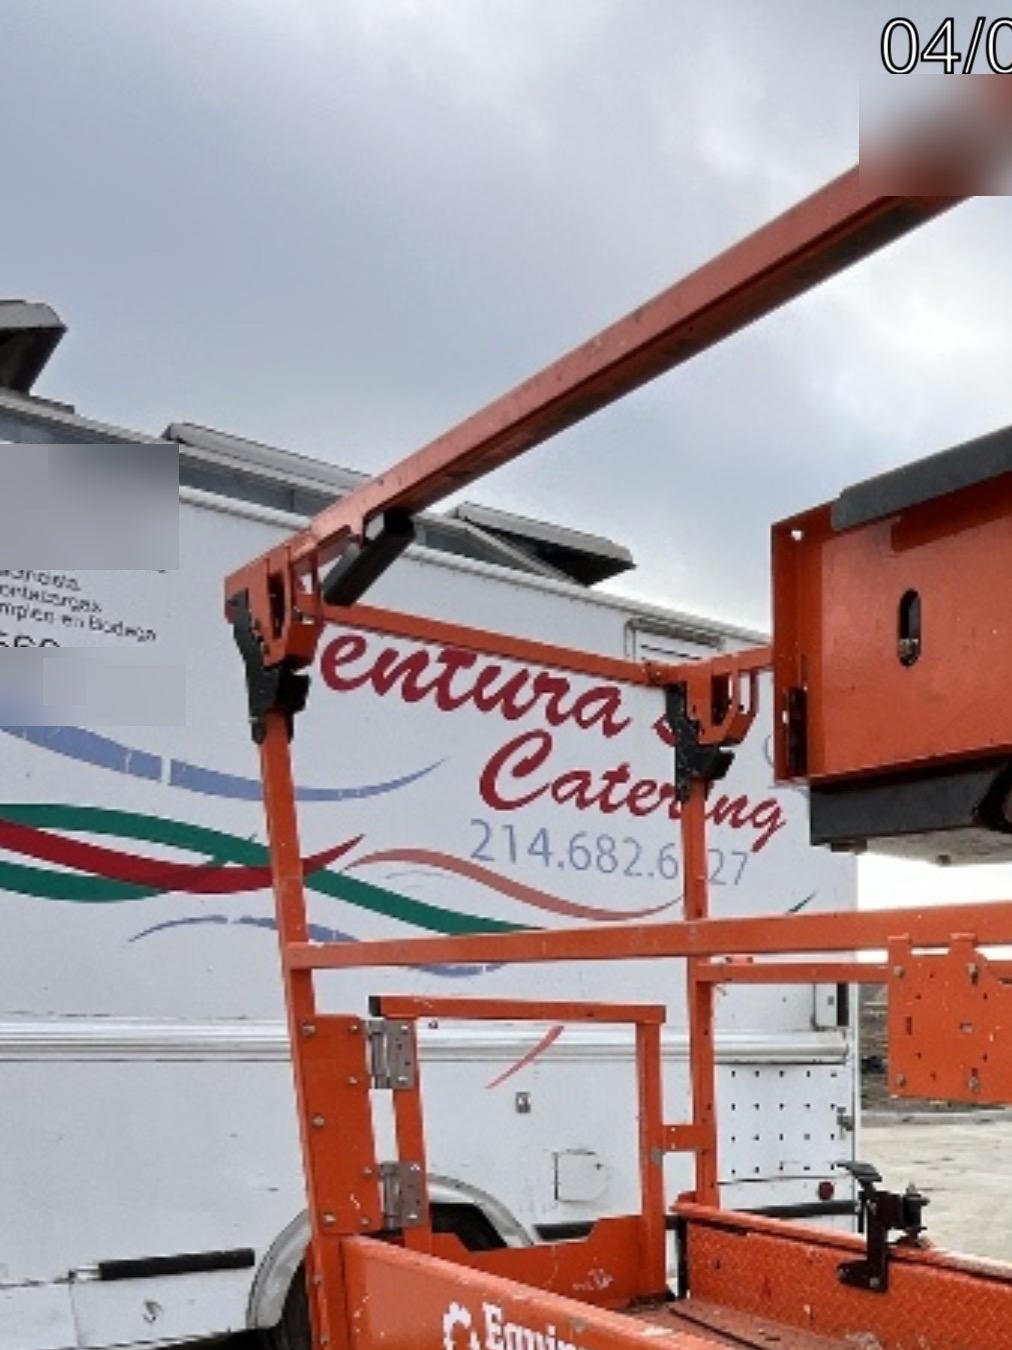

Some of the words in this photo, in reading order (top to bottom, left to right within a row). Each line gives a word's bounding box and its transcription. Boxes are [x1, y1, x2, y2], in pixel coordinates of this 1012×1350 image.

[320, 634, 631, 737] entura
[479, 729, 786, 852] Caterng
[469, 818, 748, 887] 214.682.627
